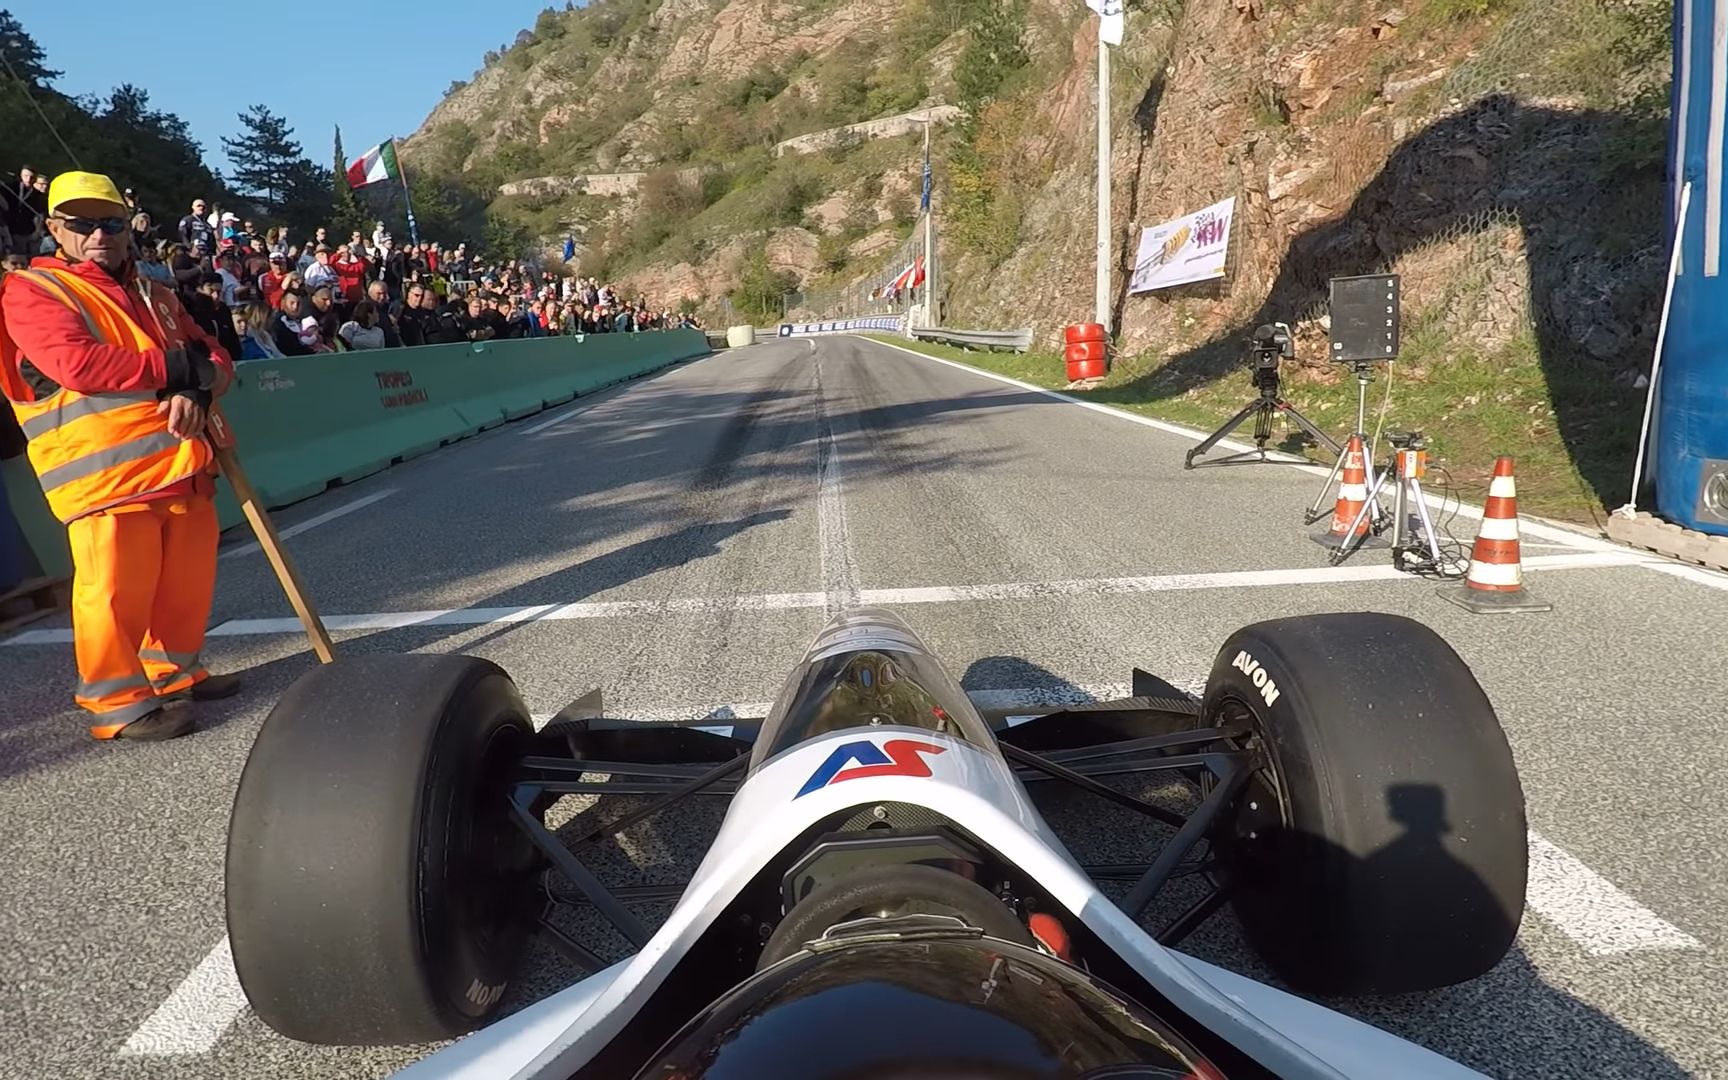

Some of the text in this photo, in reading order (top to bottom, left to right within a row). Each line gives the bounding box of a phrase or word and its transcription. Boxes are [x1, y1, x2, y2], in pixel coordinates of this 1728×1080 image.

[1386, 292, 1394, 300] 4
[1386, 306, 1393, 314] 3
[1386, 319, 1393, 327] 2
[1386, 332, 1392, 340] 1
[1231, 650, 1281, 707] AVON
[465, 977, 508, 1007] AVON
